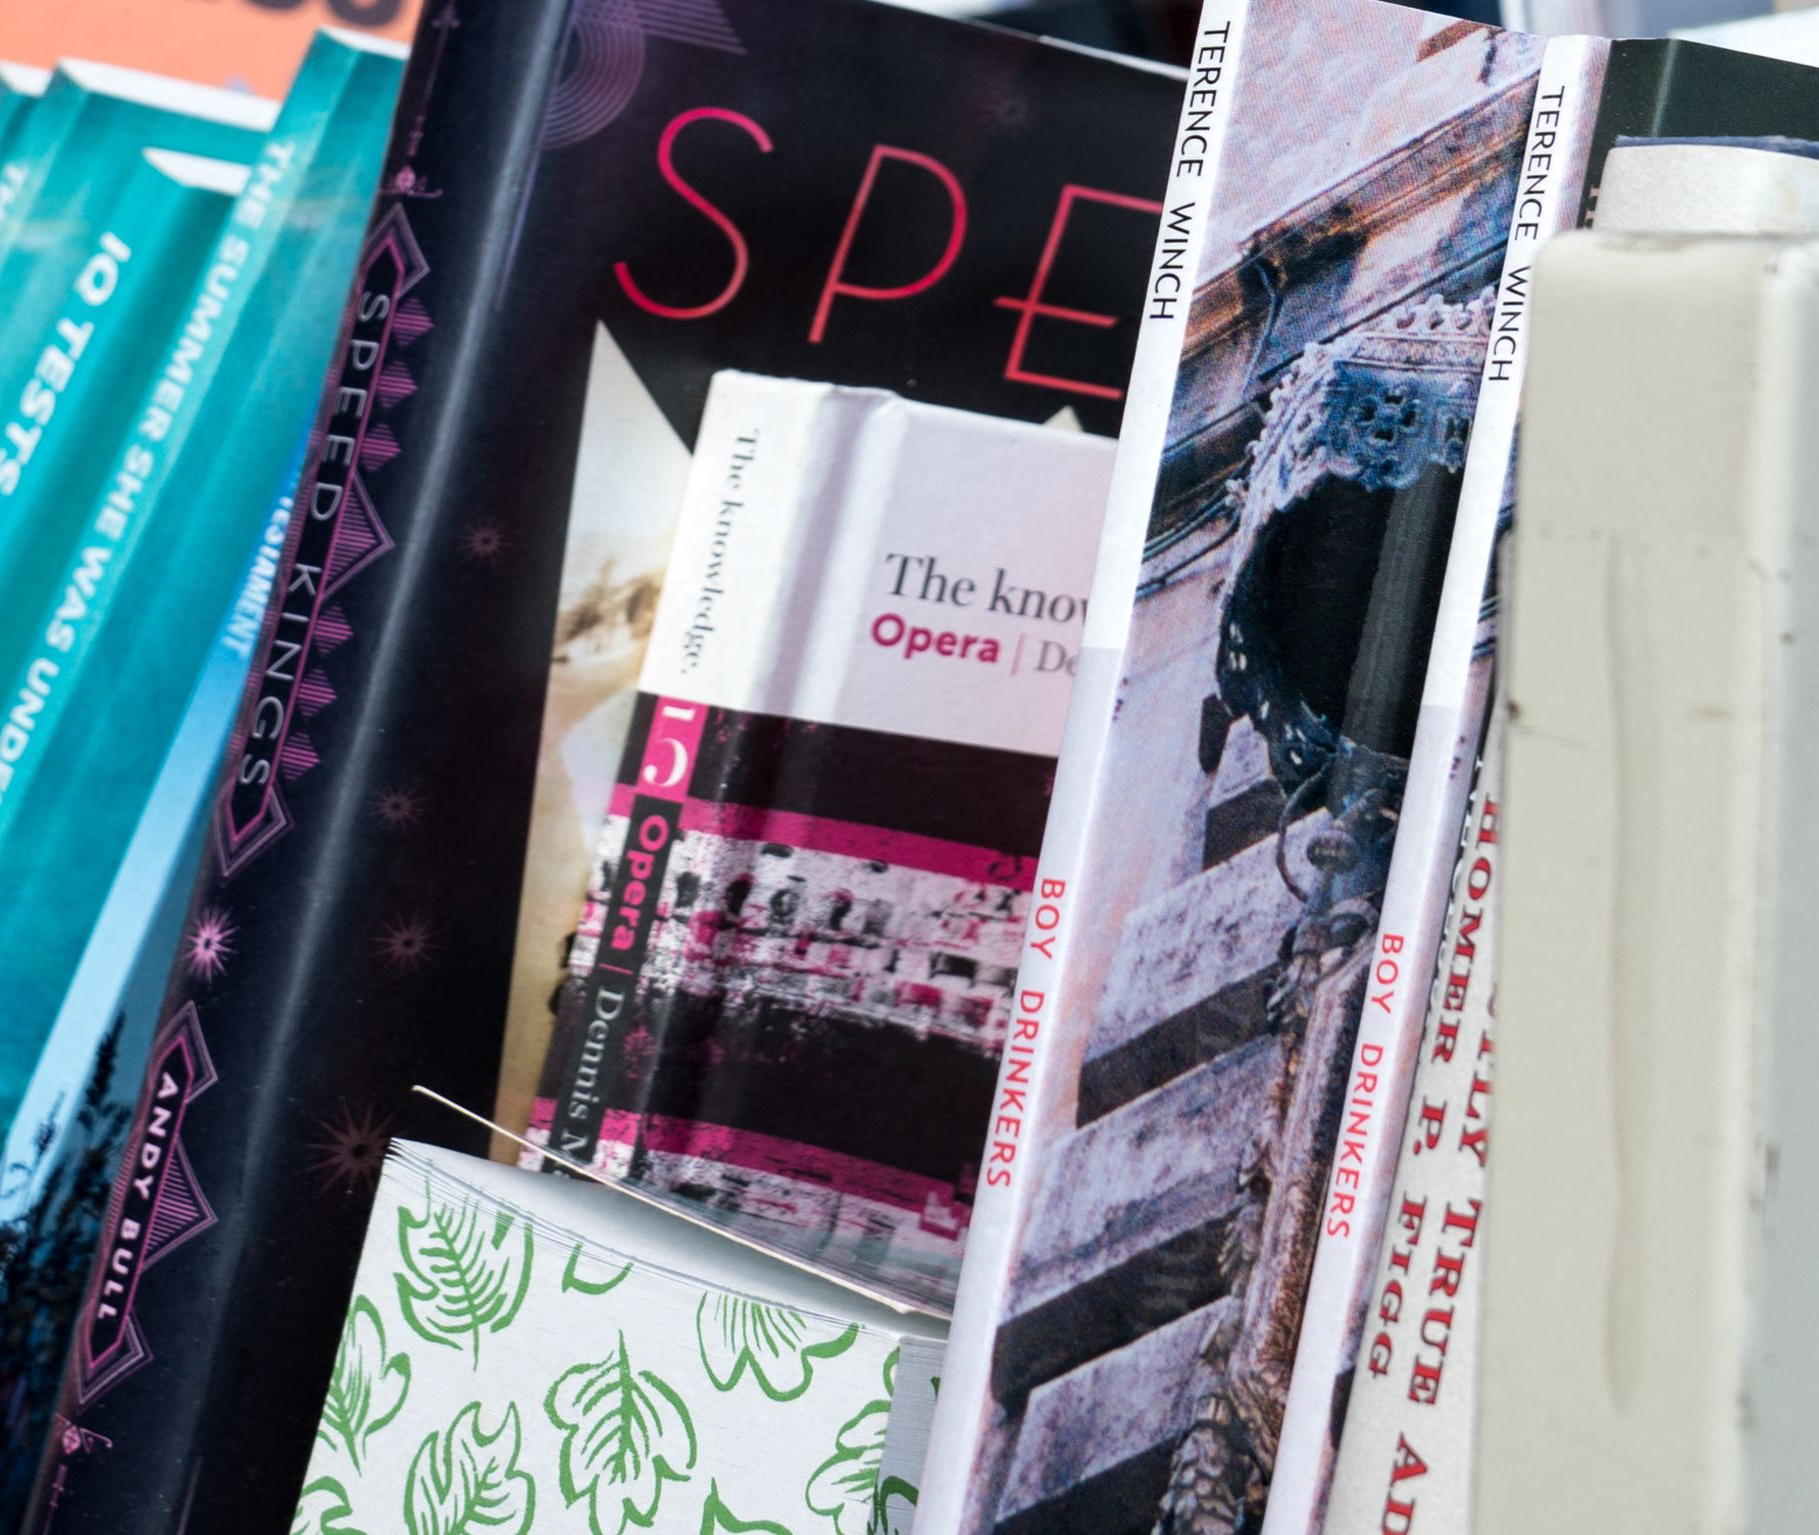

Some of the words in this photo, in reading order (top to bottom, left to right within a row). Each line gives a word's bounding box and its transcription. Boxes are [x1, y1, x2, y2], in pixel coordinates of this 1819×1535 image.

[1177, 20, 1231, 178] TERENCE
[1515, 83, 1566, 242] TERENCE
[232, 134, 296, 229] THE
[73, 229, 134, 308] IQ
[1148, 200, 1196, 321] WINCH
[1488, 265, 1532, 383] WINCH
[135, 231, 252, 444] SUMMER
[307, 290, 391, 524] SPEED
[731, 425, 760, 492] The
[91, 442, 157, 541] SHE
[40, 538, 114, 654] WAS
[679, 497, 750, 677] knowledge.
[870, 611, 1002, 665] Opera
[885, 551, 976, 608] The
[236, 562, 325, 787] KINGS
[643, 705, 695, 787] 15
[611, 814, 670, 952] Opera
[1030, 877, 1067, 961] BOY
[1430, 792, 1500, 1064] HOMER
[1371, 932, 1405, 1016] BOY
[568, 984, 625, 1121] Dennis
[986, 989, 1047, 1190] DRINKERS
[121, 1072, 174, 1218] ANDY
[1326, 1043, 1386, 1240] DRINKERS
[1412, 1096, 1449, 1157] P.
[96, 1222, 142, 1321] BULL
[1368, 1191, 1428, 1380] FIGG
[1406, 1197, 1484, 1406] TRUE
